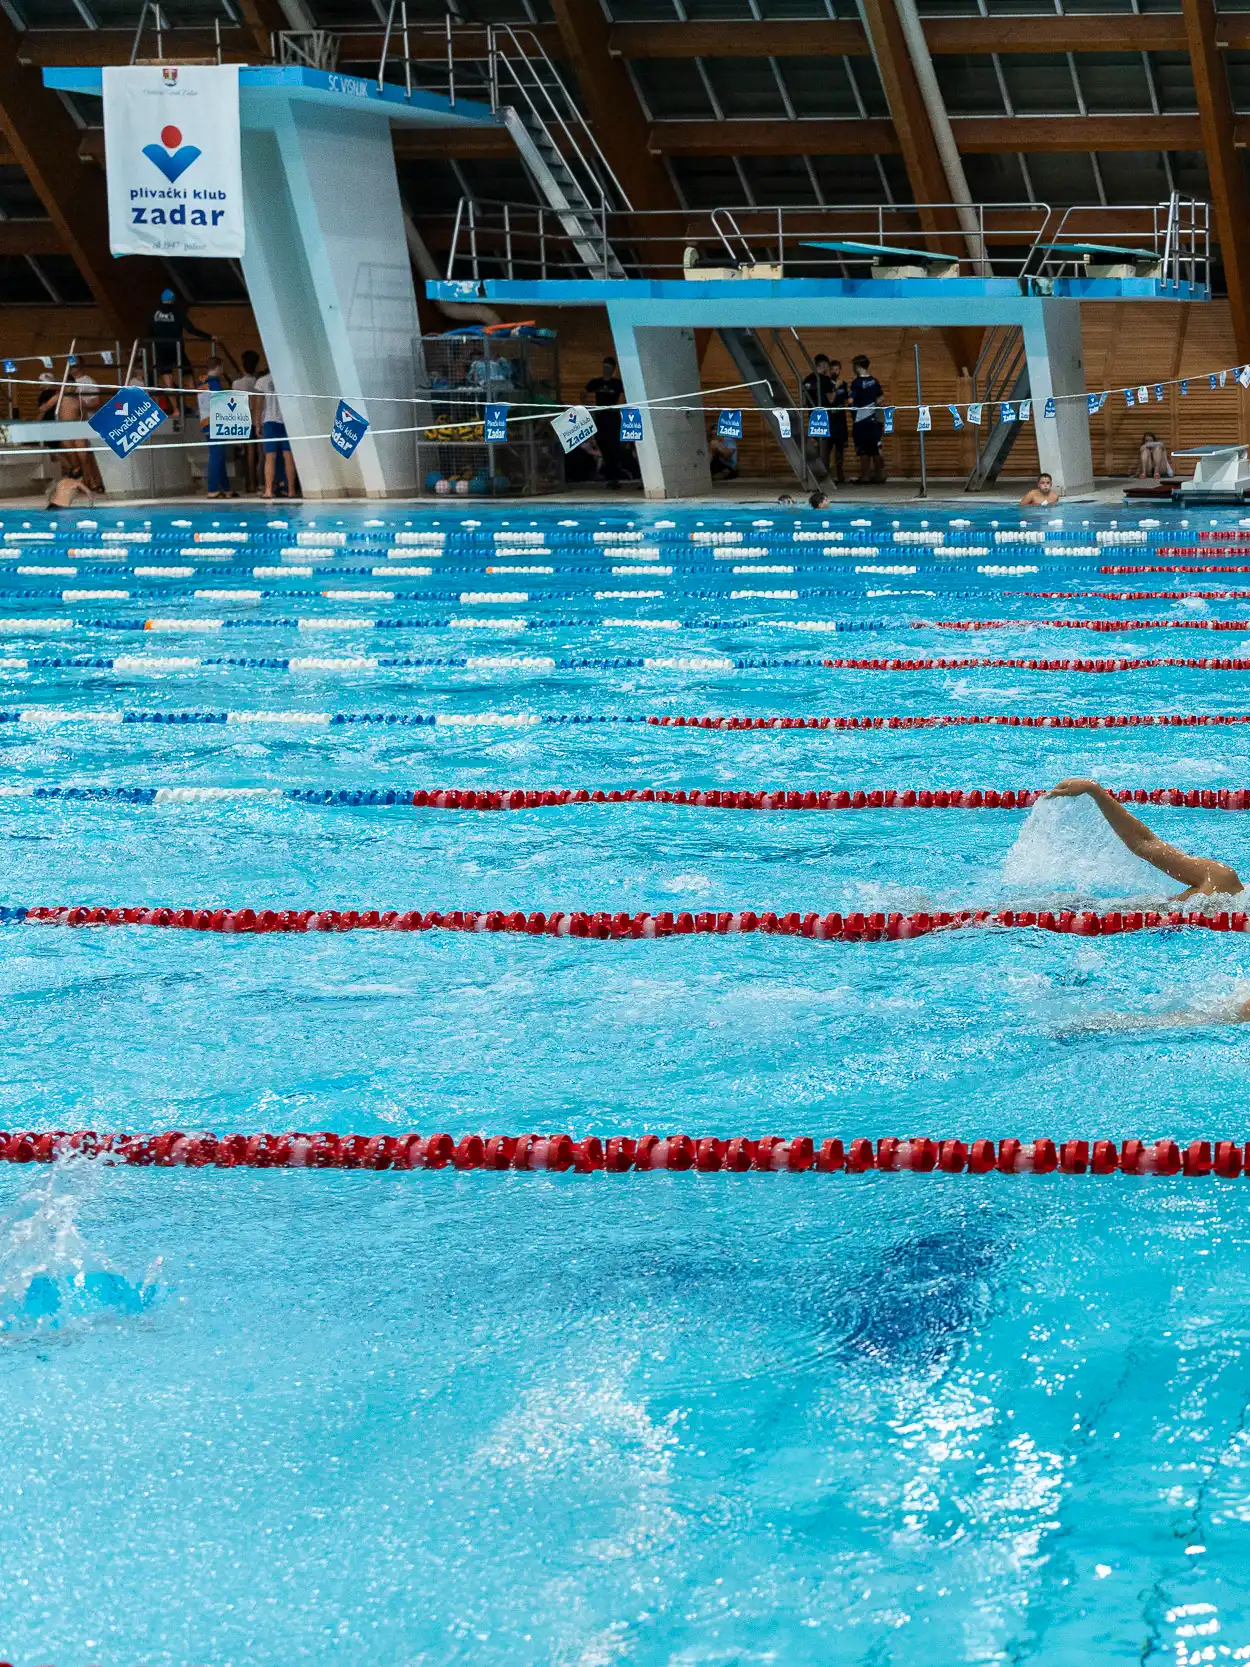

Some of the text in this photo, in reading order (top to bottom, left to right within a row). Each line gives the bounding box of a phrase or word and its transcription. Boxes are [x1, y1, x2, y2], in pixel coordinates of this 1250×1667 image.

[193, 190, 227, 200] klub
[131, 204, 225, 226] zadar
[108, 400, 152, 441] Plivački klub
[215, 412, 249, 422] Plivački klub
[116, 410, 161, 453] Zadar
[216, 423, 250, 436] Zadar
[344, 427, 358, 441] klub
[487, 428, 506, 439] Zadar
[562, 416, 591, 439] Plivački klub
[719, 425, 740, 436] Zadar
[810, 426, 828, 435] Zadar
[566, 423, 595, 448] Zadar
[621, 429, 642, 440] Zadar
